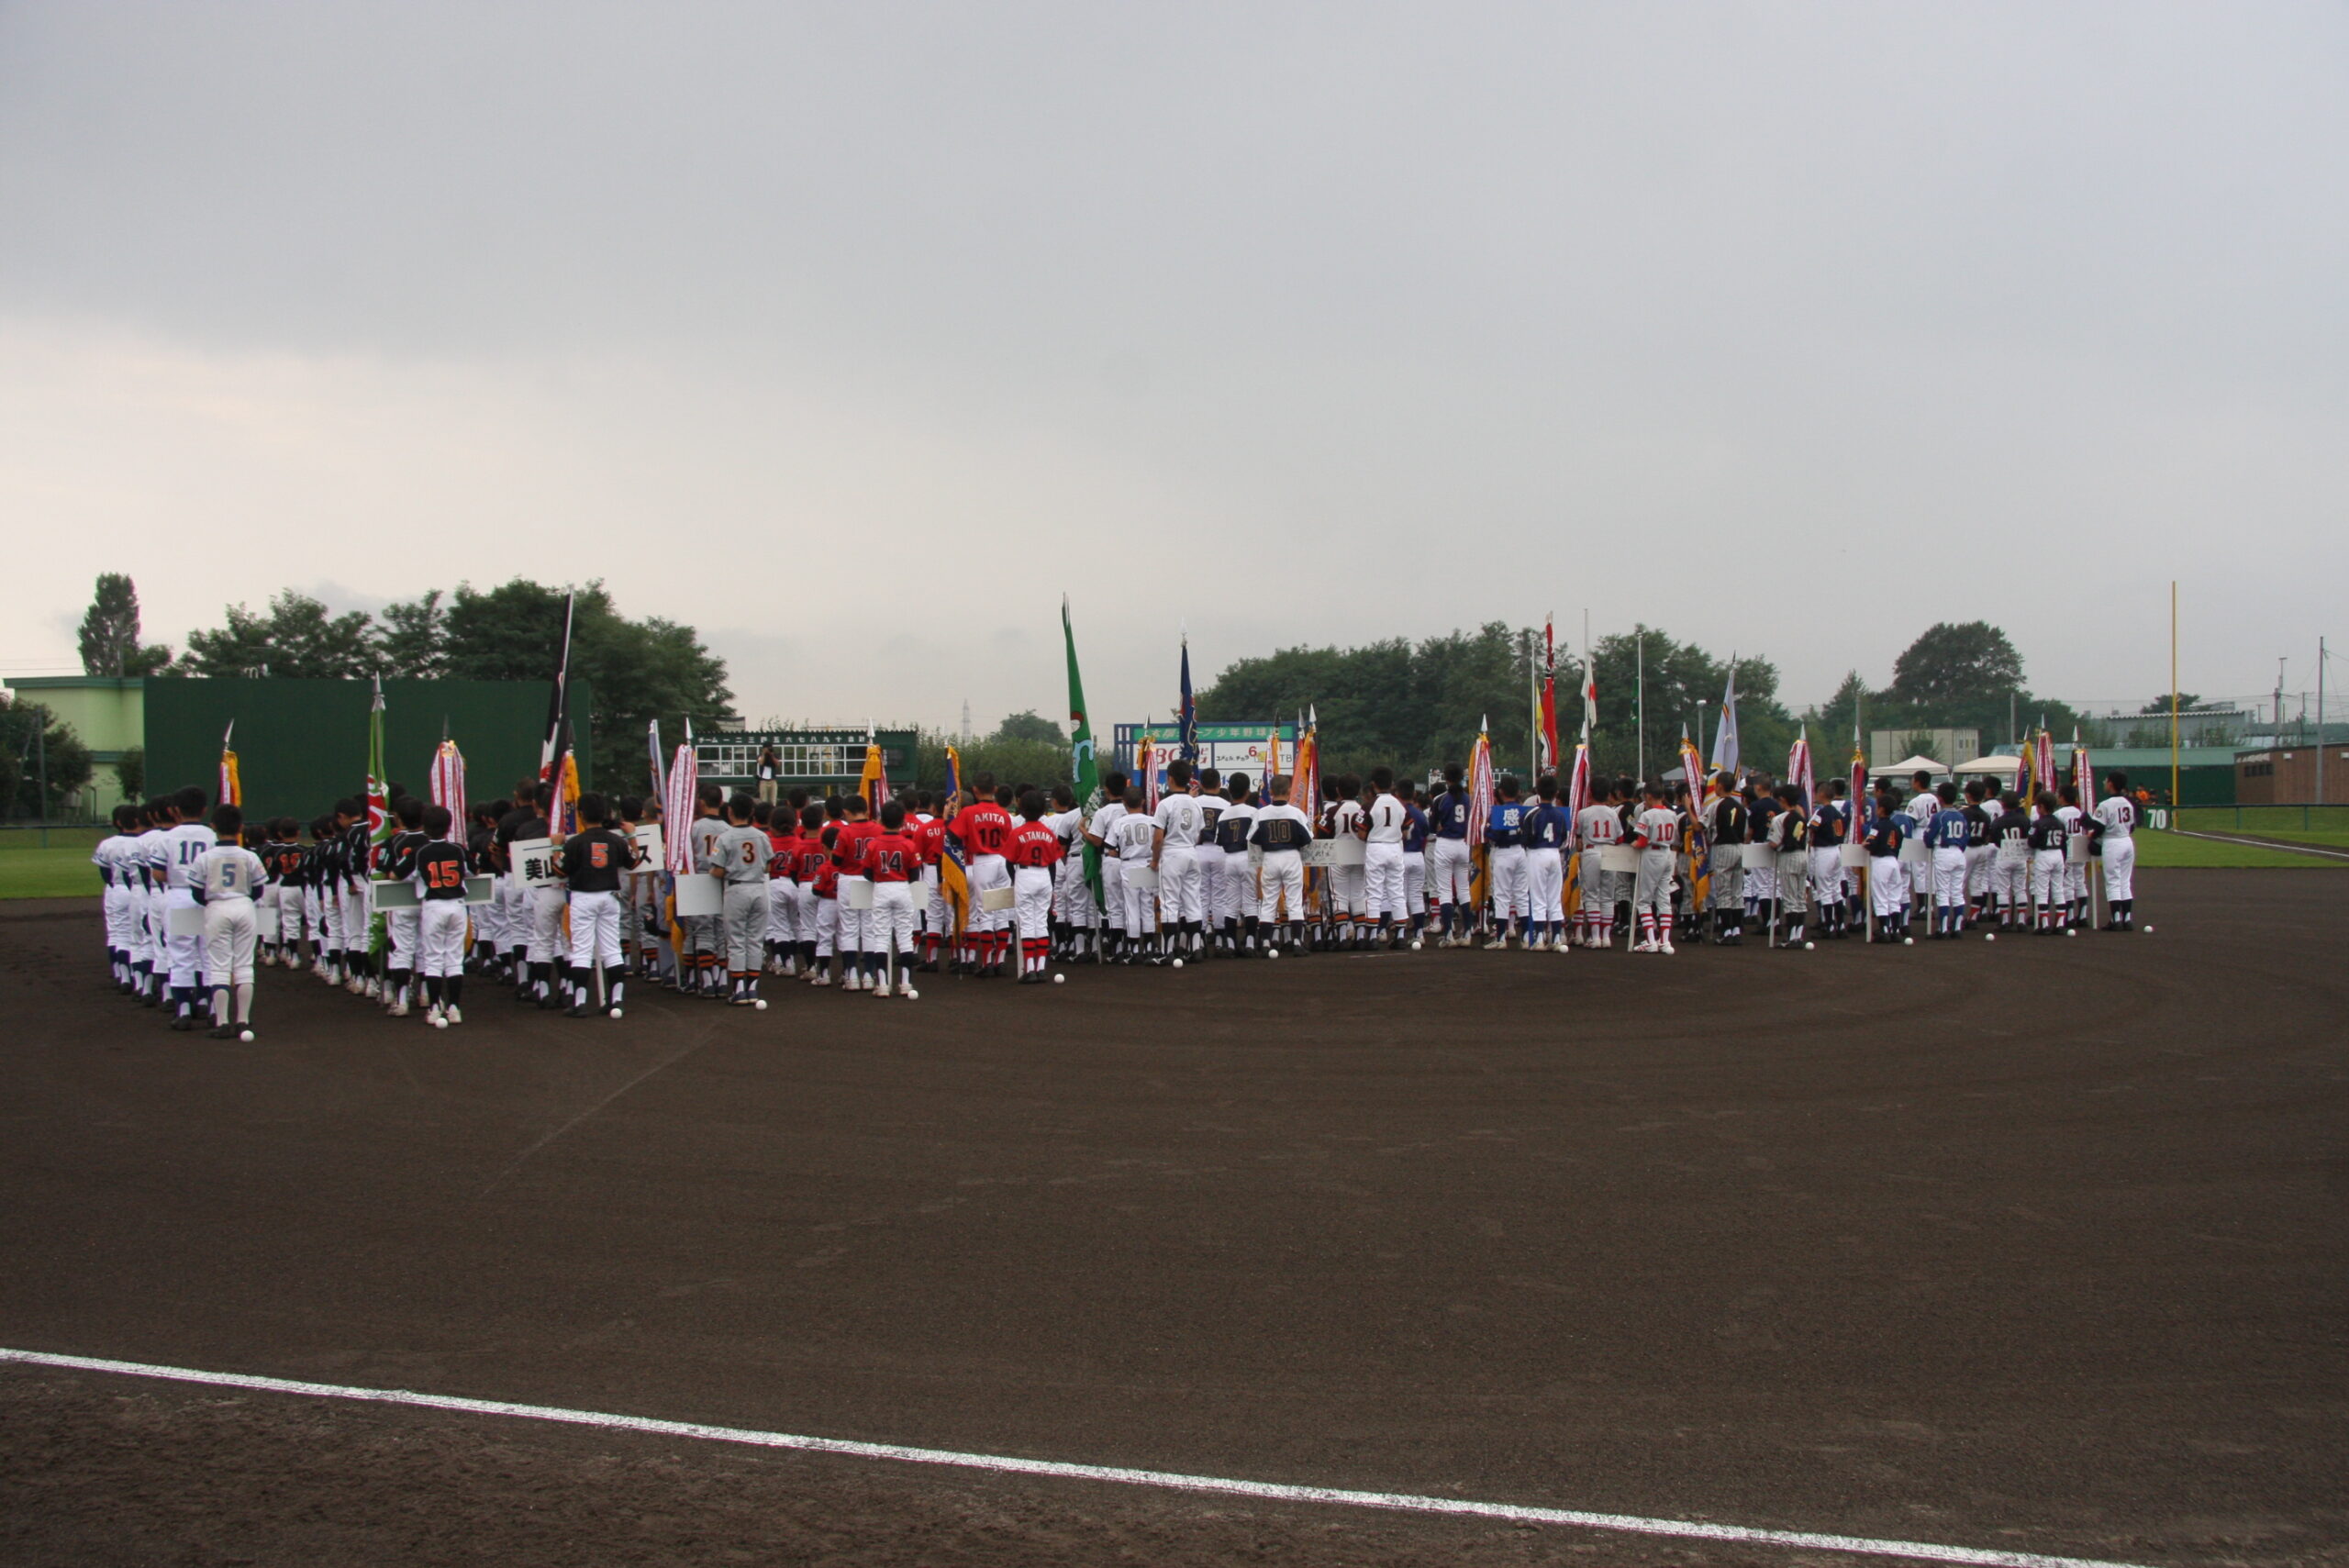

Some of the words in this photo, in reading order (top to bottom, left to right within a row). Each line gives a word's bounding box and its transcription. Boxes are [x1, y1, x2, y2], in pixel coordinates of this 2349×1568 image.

[1248, 746, 1257, 757] 6
[1279, 754, 1292, 762] TB
[974, 812, 1006, 826] AKITA
[1181, 808, 1192, 830] 3
[1384, 806, 1391, 827] 1
[1454, 805, 1464, 823] 9
[1731, 807, 1737, 827] 1
[2118, 806, 2131, 824] 13
[2147, 808, 2166, 829] 70
[1123, 824, 1149, 846] 10
[1229, 819, 1240, 842] 7
[1267, 820, 1291, 843] 10
[1543, 823, 1554, 843] 4
[1593, 820, 1611, 838] 11
[1656, 823, 1674, 841] 10
[1947, 820, 1964, 839] 10
[2067, 818, 2080, 834] 10
[979, 828, 1002, 849] 10
[2046, 829, 2063, 846] 16
[591, 842, 608, 868] 5
[741, 841, 755, 864] 3
[880, 851, 902, 873] 14
[222, 863, 236, 887] 5
[428, 861, 460, 888] 15
